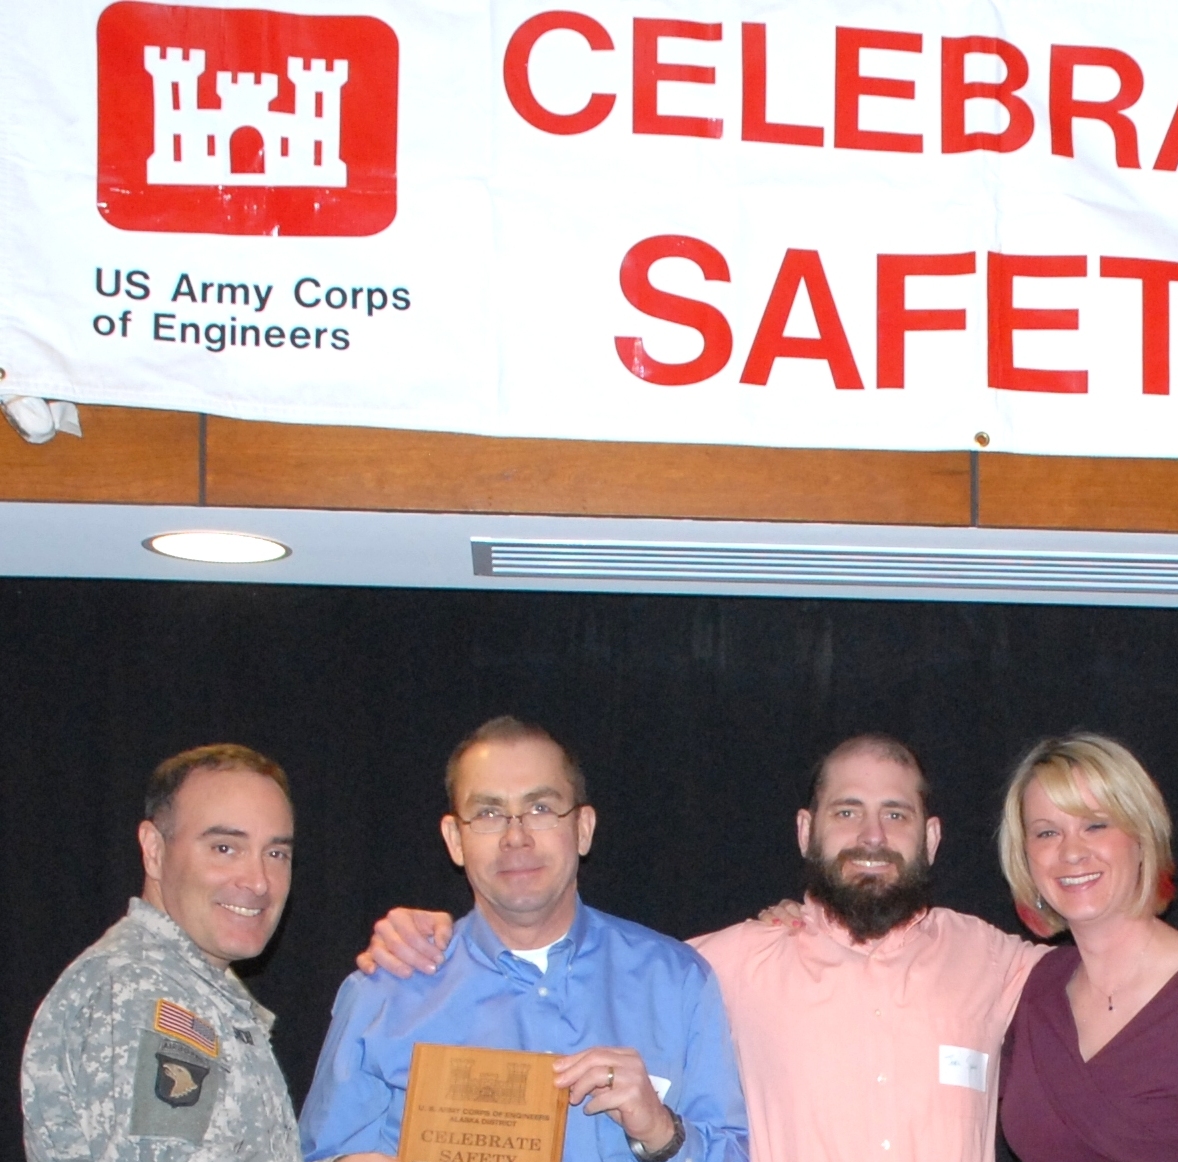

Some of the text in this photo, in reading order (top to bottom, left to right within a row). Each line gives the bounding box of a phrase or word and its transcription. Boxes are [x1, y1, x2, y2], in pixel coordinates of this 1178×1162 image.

[95, 267, 411, 316] US Army Corps
[93, 310, 350, 353] of Engineers
[449, 1116, 518, 1127] ALASKA DISTRICT
[462, 1108, 491, 1117] CORPS
[492, 1110, 503, 1118] OF
[504, 1112, 550, 1120] ENGINEERS
[421, 1130, 541, 1150] CELEBRATE
